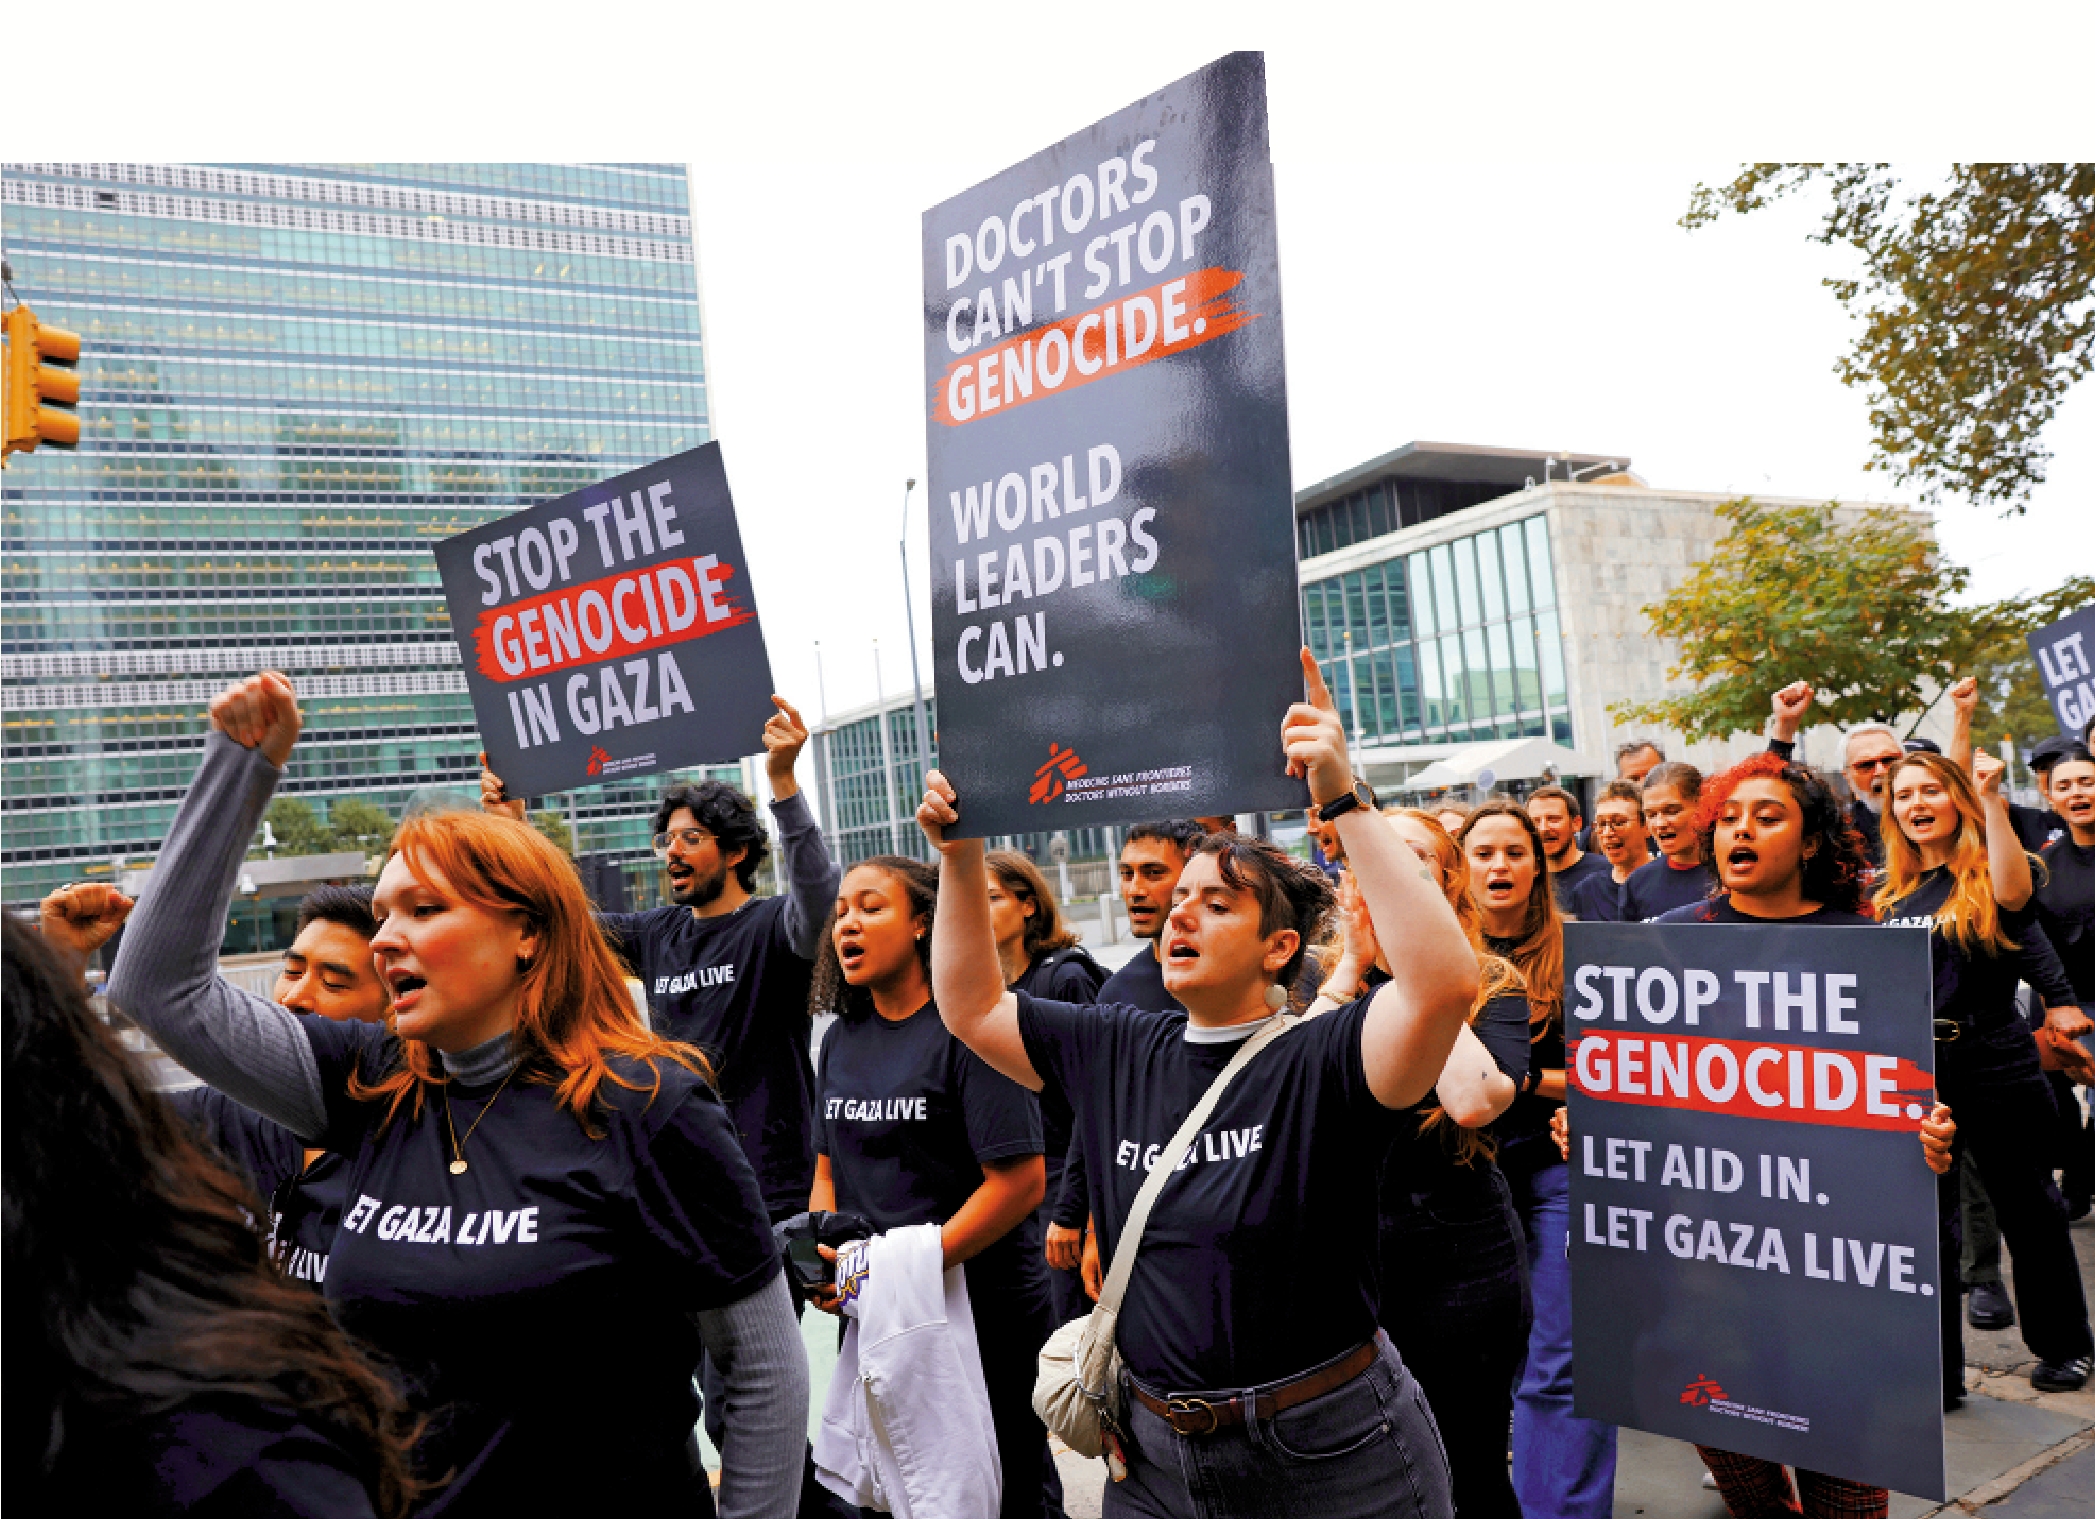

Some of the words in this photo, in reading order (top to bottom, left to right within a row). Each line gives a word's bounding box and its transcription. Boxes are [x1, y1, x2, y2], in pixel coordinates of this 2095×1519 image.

[946, 139, 1158, 290] DOCTORS
[946, 251, 1072, 354] CAN'T
[1084, 194, 1211, 299] STOP
[948, 278, 1207, 421] GENOCIDE.
[949, 443, 1122, 544] WORLD
[473, 518, 580, 606] STOP
[584, 479, 685, 568] THE
[955, 507, 1158, 615] LEADERS
[493, 553, 732, 675] GENOCIDE
[957, 611, 1064, 684] CAN.
[507, 683, 561, 749] IN
[566, 651, 694, 735] GAZA
[2039, 632, 2090, 688] LET
[699, 964, 735, 987] LIVE
[1573, 964, 1720, 1025] STOP
[1734, 970, 1860, 1034] THE
[885, 1097, 927, 1121] LIVE
[1575, 1035, 1923, 1119] GENOCIDE.
[1115, 1139, 1140, 1171] ET
[1204, 1125, 1264, 1162] LIVE
[1583, 1135, 1652, 1182] LET
[1661, 1144, 1744, 1193] AID
[1760, 1154, 1830, 1205] IN.
[344, 1194, 382, 1234] ET
[377, 1205, 452, 1243] GAZA
[455, 1206, 539, 1245] LIVE
[1584, 1204, 1652, 1251] LET
[1664, 1213, 1790, 1274] GAZA
[1804, 1232, 1934, 1296] LIVE.
[297, 1248, 329, 1282] LIV
